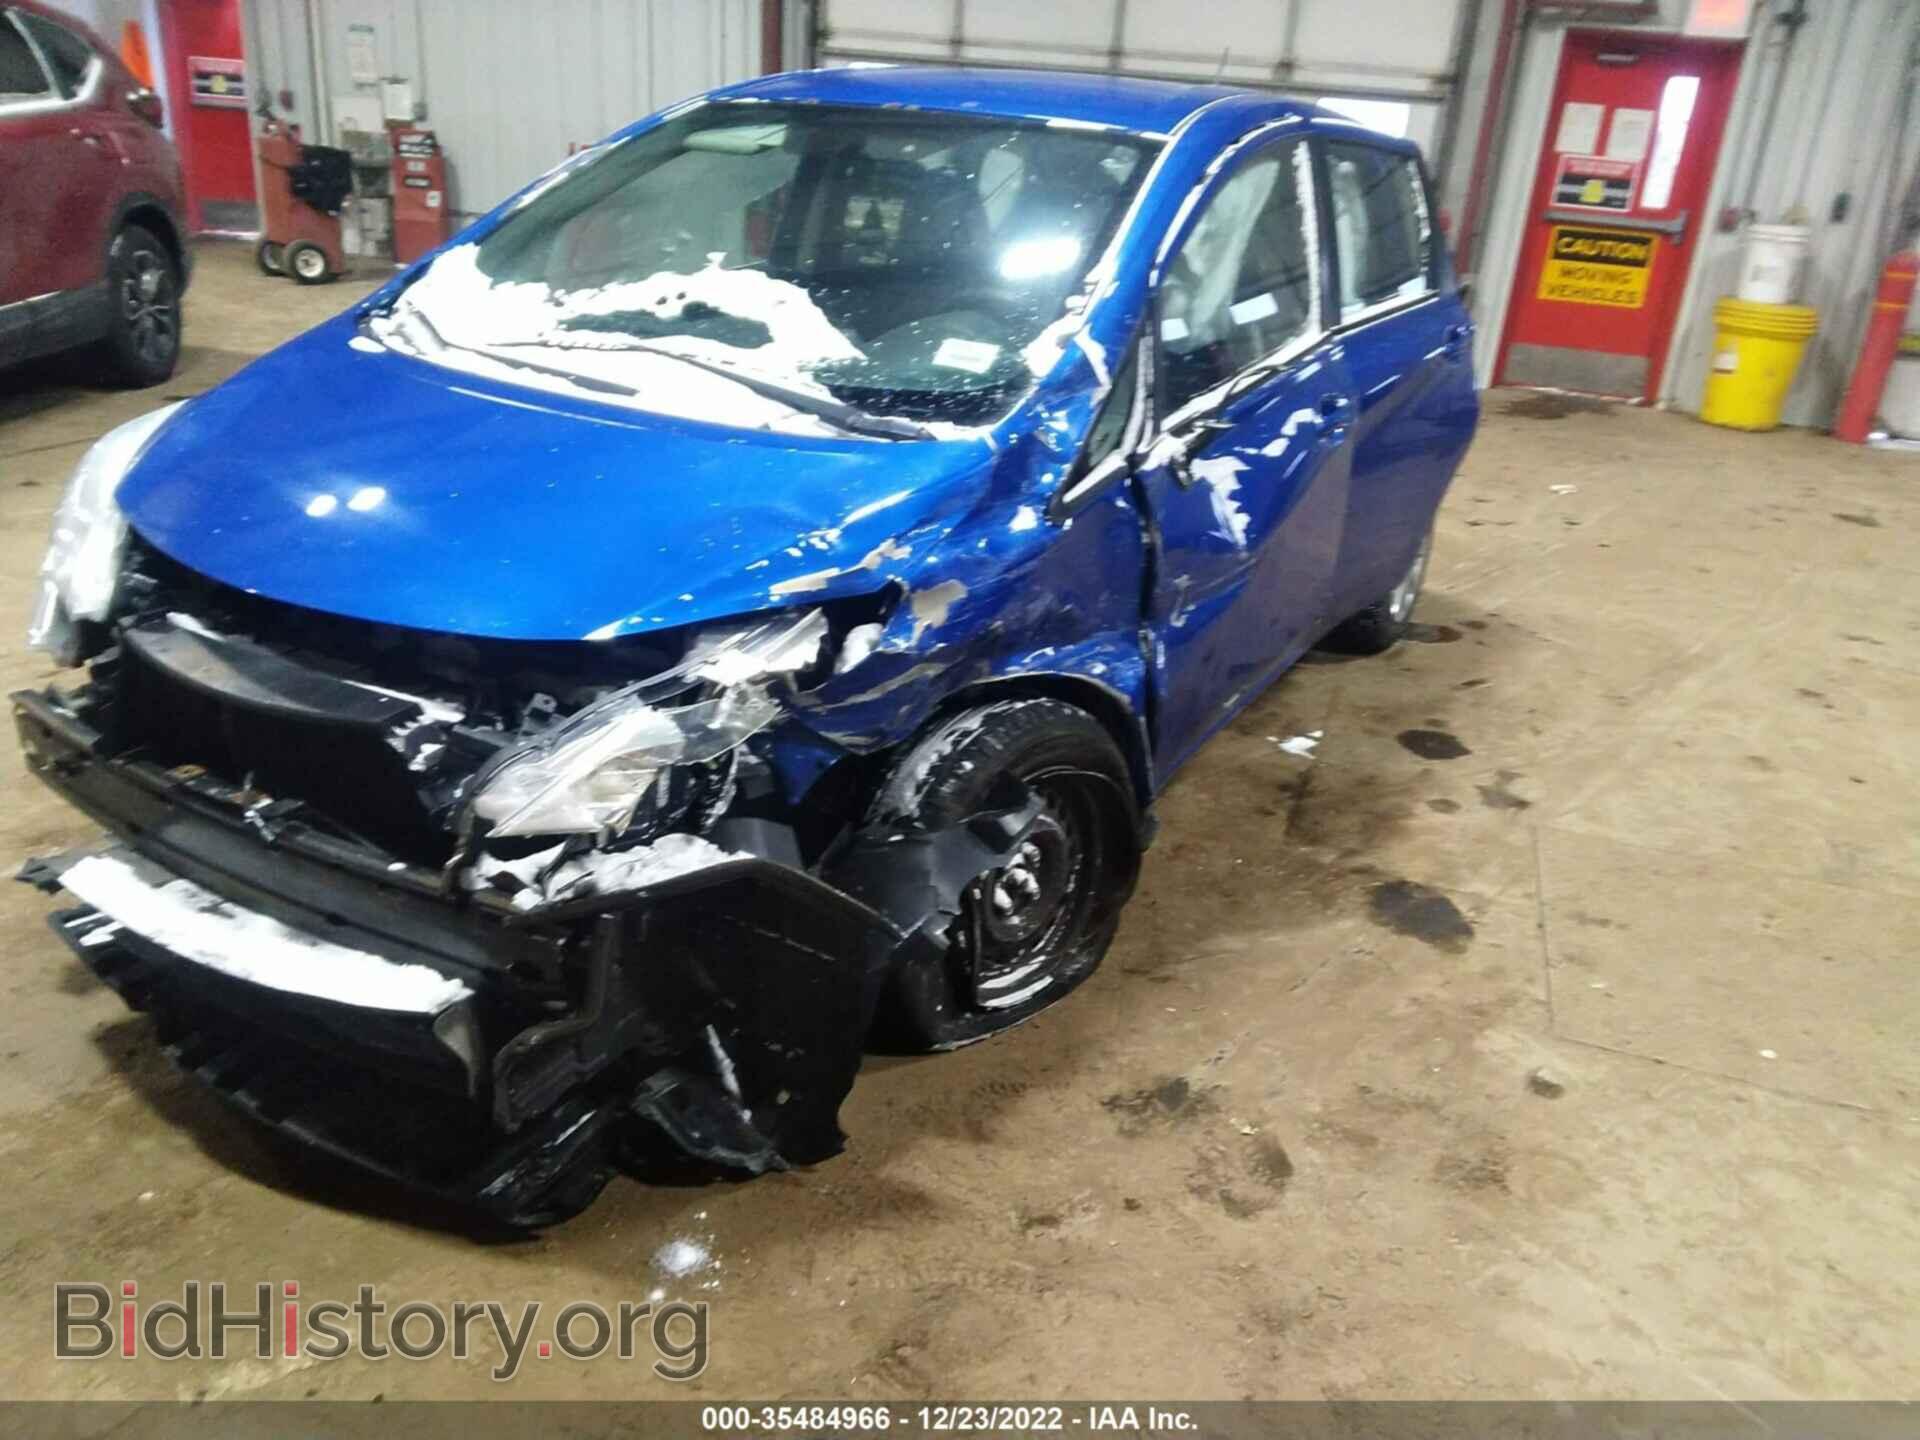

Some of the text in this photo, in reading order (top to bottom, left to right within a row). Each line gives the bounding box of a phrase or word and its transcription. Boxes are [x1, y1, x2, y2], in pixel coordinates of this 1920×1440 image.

[1556, 237, 1649, 260] CAUTION
[1558, 266, 1633, 285] MOVING
[1545, 284, 1639, 304] VEHICLES
